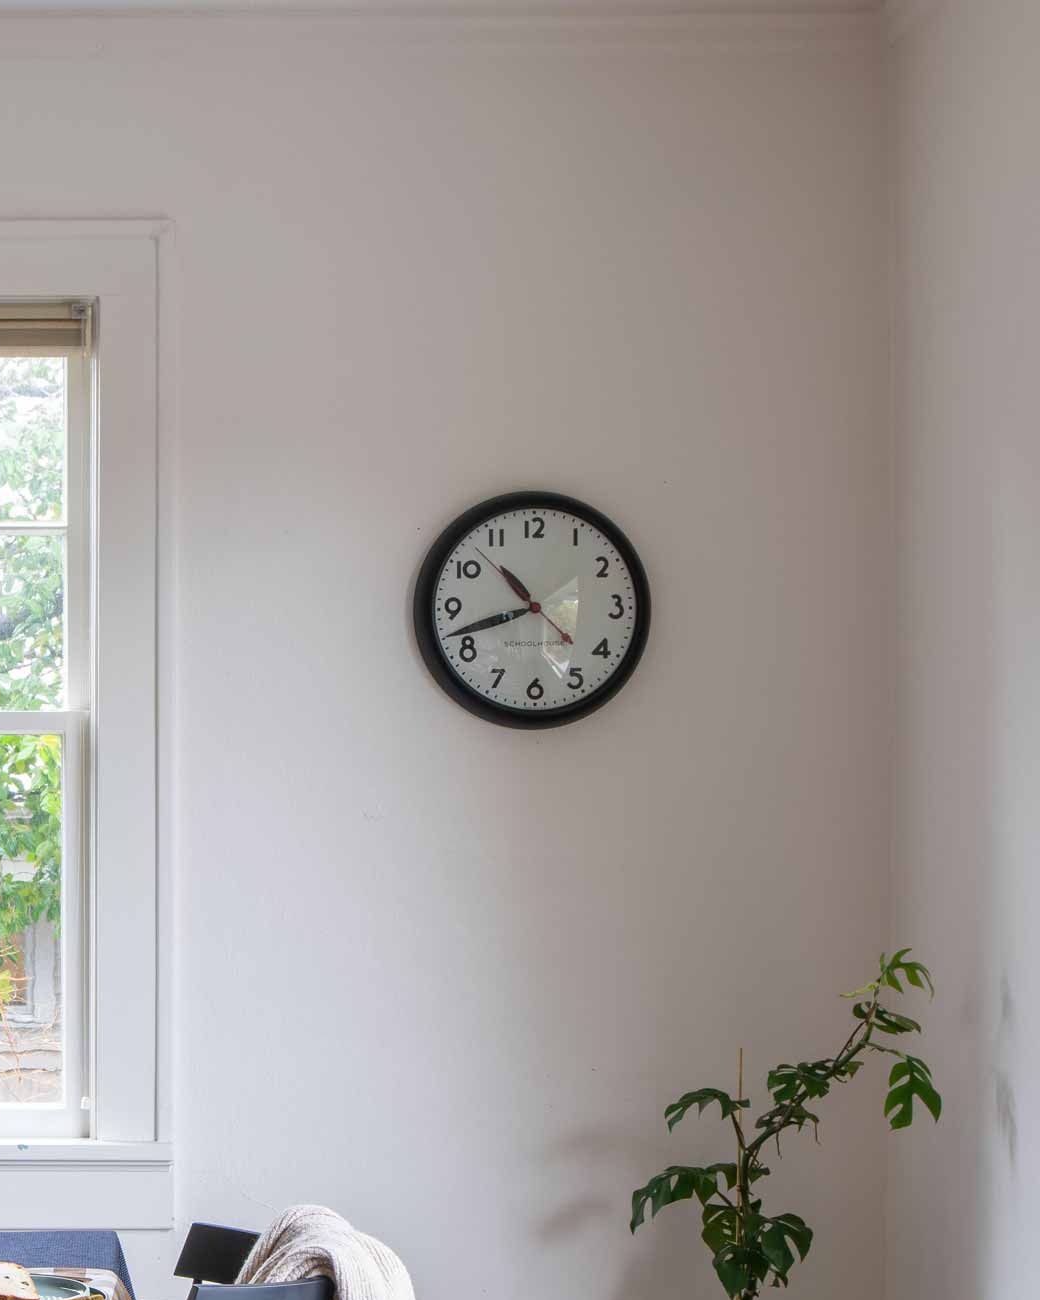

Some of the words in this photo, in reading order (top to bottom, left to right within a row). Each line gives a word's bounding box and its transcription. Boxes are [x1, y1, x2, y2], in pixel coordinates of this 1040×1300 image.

[488, 529, 504, 547] 11
[524, 517, 545, 538] 12
[573, 528, 578, 546] 1
[456, 560, 481, 579] 10
[595, 556, 609, 578] 2
[444, 597, 462, 620] 9
[608, 594, 625, 619] 3
[459, 635, 477, 663] 8
[503, 640, 565, 648] SCHOOLHOUSE
[591, 638, 611, 659] 4
[491, 668, 506, 689] 7
[526, 678, 544, 700] 6
[567, 667, 584, 690] 5
